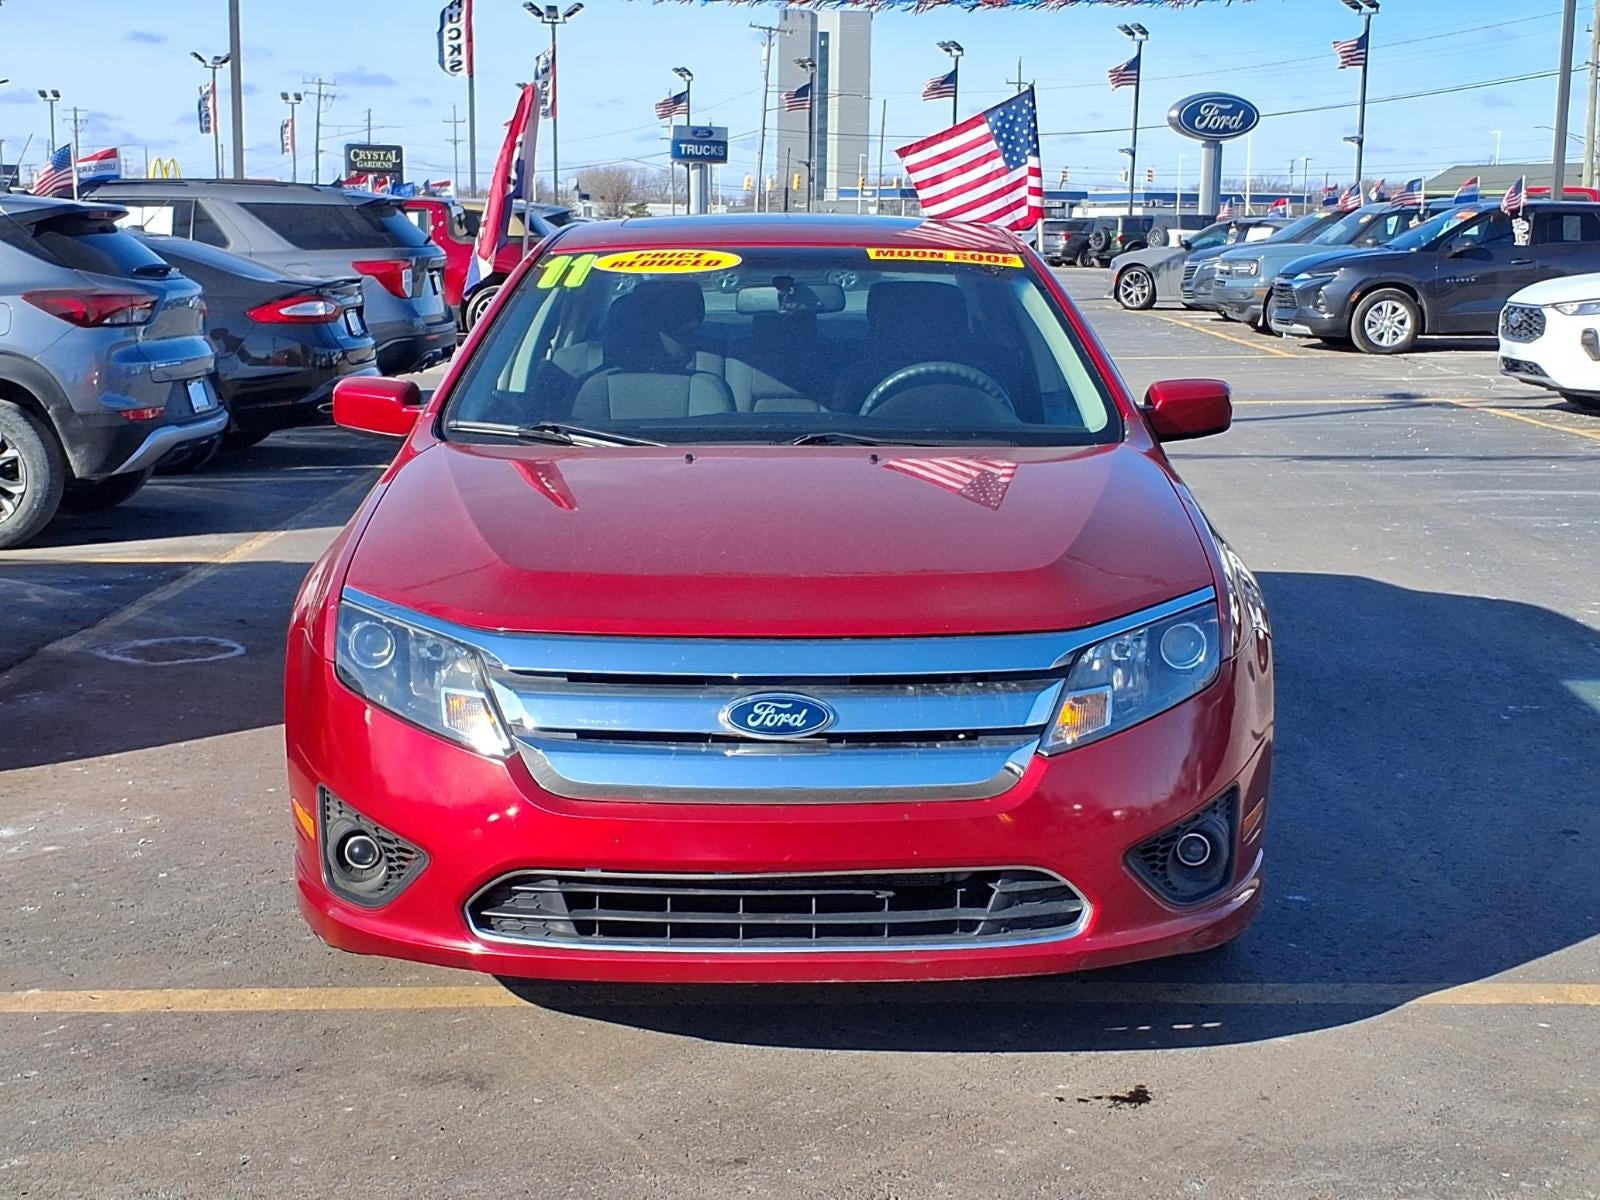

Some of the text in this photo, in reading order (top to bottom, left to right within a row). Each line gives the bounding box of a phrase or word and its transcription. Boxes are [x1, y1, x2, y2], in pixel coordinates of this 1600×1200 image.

[1194, 102, 1244, 130] Ford
[350, 148, 401, 163] CRYSTAL
[679, 143, 725, 156] TRUCKS
[634, 251, 705, 260] PRICE
[875, 249, 1017, 264] MOON ROOF
[609, 259, 722, 268] REDUCED
[537, 254, 597, 289] 11
[747, 701, 808, 727] Ford
